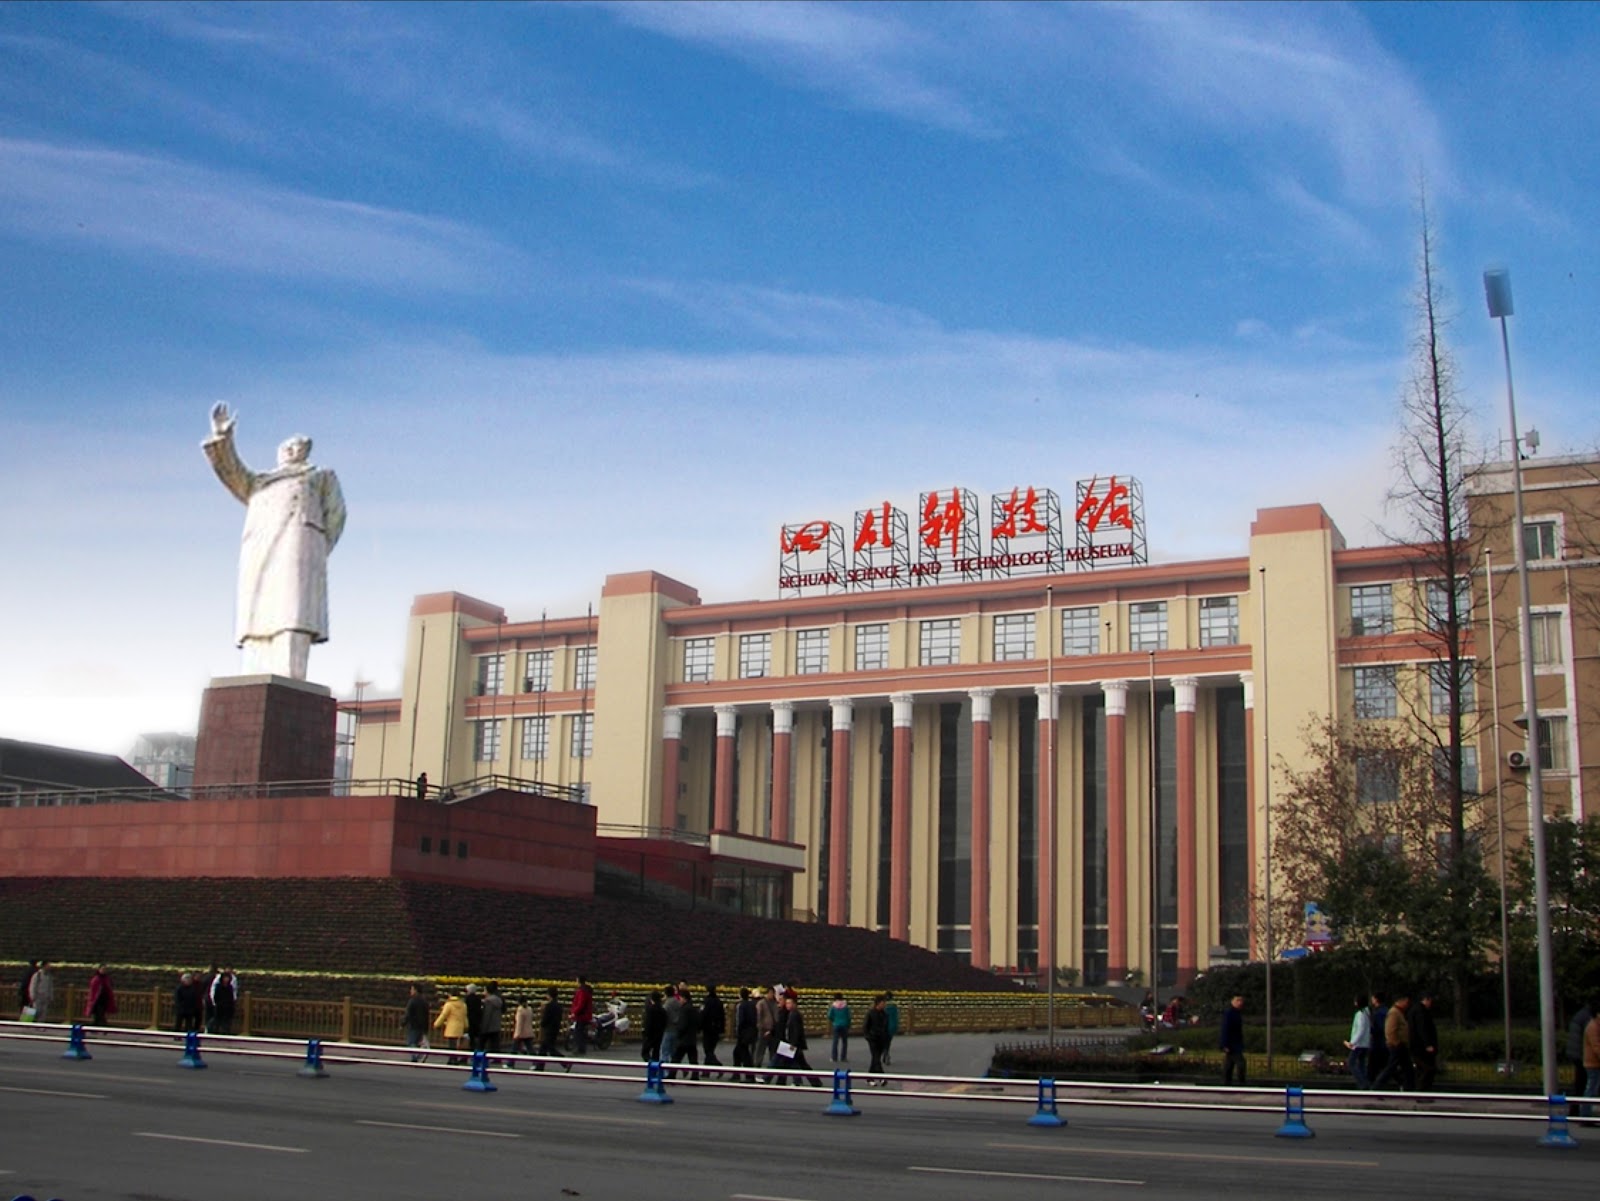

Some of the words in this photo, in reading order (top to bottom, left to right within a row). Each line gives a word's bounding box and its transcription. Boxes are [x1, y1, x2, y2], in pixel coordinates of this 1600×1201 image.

[779, 572, 838, 589] SICHUAN
[848, 565, 900, 582] SCIENCE
[909, 561, 942, 577] AND
[952, 551, 1052, 572] TECHNOLOGY
[1066, 543, 1133, 562] MUSEUM
